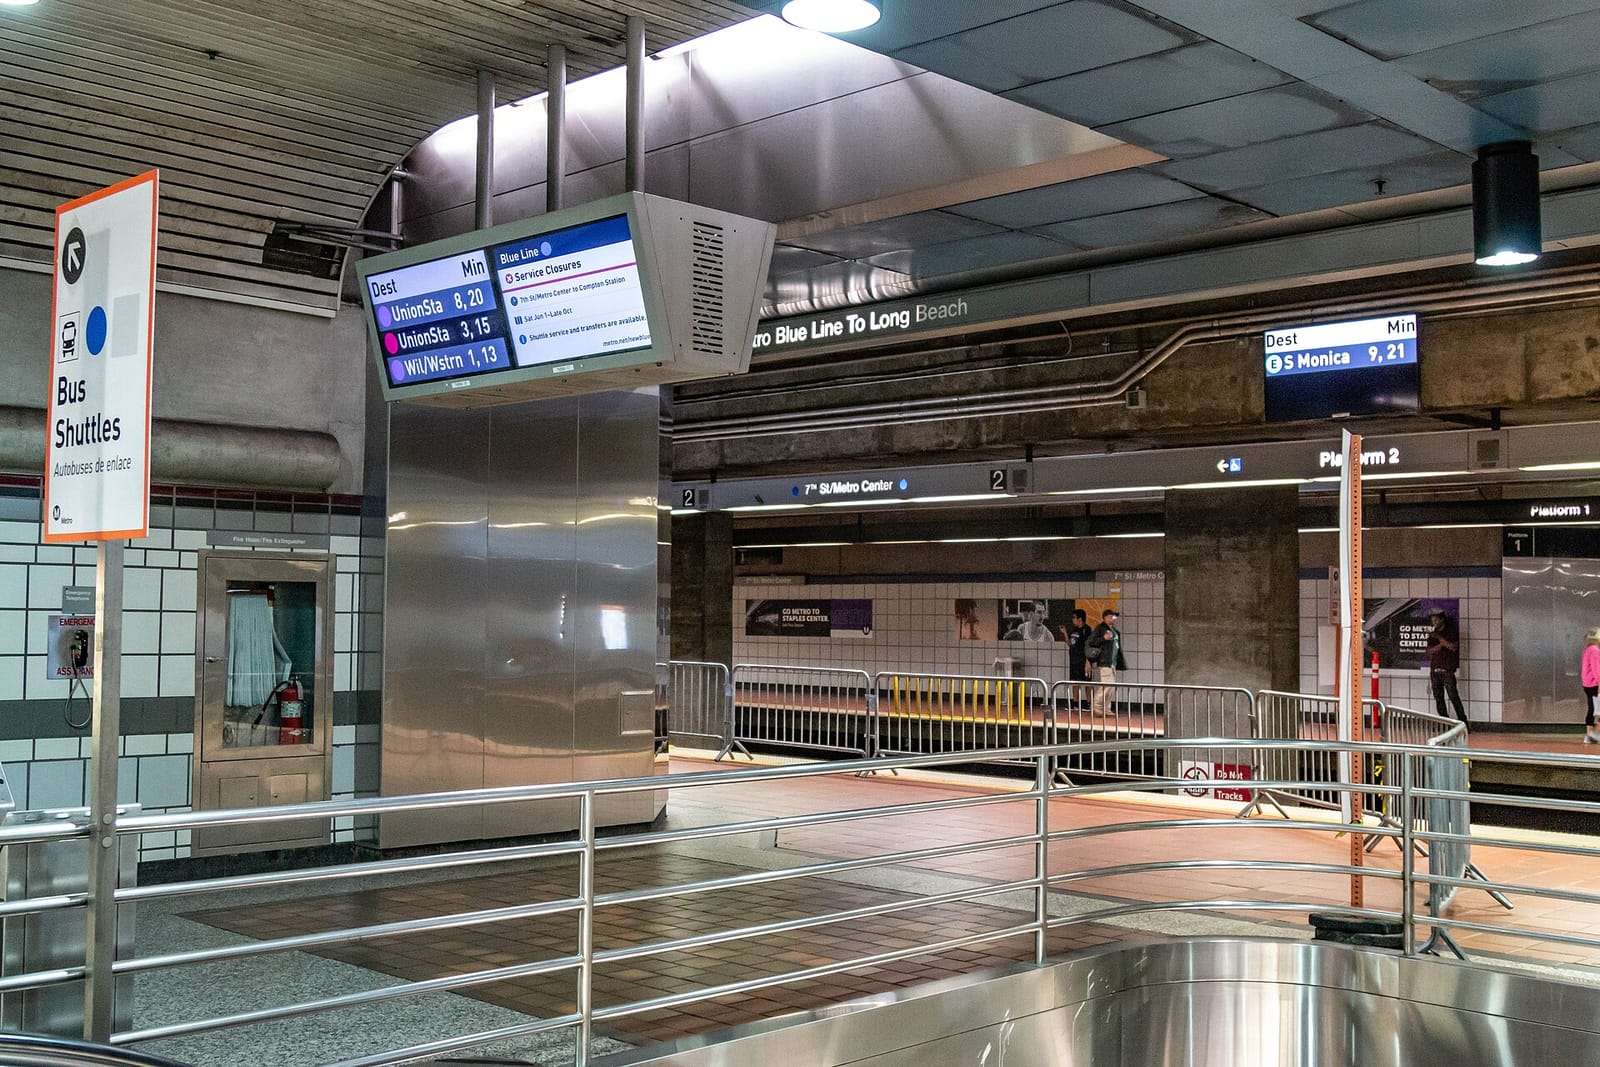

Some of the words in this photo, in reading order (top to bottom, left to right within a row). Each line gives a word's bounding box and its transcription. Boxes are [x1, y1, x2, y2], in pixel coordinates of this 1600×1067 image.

[500, 252, 520, 264] Blue
[520, 247, 540, 260] Line
[372, 279, 398, 298] Dest
[461, 259, 486, 278] Min
[514, 268, 544, 282] Service
[545, 259, 582, 275] Closures
[529, 292, 552, 302] St/Metro
[553, 286, 572, 297] Center
[579, 281, 605, 294] Compton
[605, 276, 626, 287] Station
[391, 298, 444, 322] UnionSta
[454, 292, 468, 311] 8,
[468, 288, 484, 307] 20
[524, 314, 534, 322] Sat
[534, 312, 544, 321] Jun
[562, 307, 573, 316] Oct
[398, 326, 450, 349] UnionSta
[460, 321, 474, 340] 3,
[474, 316, 491, 335] 15
[530, 332, 548, 342] Shuttle
[549, 328, 569, 338] service
[570, 326, 580, 334] and
[580, 321, 607, 332] transfers
[776, 326, 808, 344] Blue
[812, 320, 844, 339] Line
[846, 314, 866, 334] To
[870, 310, 910, 330] Long
[916, 298, 968, 322] Beach
[1266, 332, 1298, 348] Dest
[1388, 319, 1415, 334] Min
[404, 354, 464, 376] Wil/Wstrn
[468, 349, 481, 368] 1,
[481, 345, 498, 364] 13
[1284, 354, 1294, 370] S
[1298, 350, 1350, 368] Monica
[1368, 346, 1384, 363] 9,
[1386, 343, 1405, 360] 21
[57, 376, 86, 406] Bus
[55, 412, 121, 448] Shuttles
[54, 460, 93, 477] Autobuses
[95, 456, 104, 473] de
[106, 454, 132, 472] enlace
[1388, 448, 1400, 464] 2
[819, 482, 860, 494] St/Metro
[861, 480, 893, 492] Center
[992, 470, 1004, 490] 2
[684, 490, 693, 506] 2
[1530, 504, 1581, 518] Platform
[1584, 504, 1590, 516] 1
[1514, 539, 1521, 552] 1
[1217, 770, 1228, 778] Do
[1216, 790, 1244, 801] Tracks
